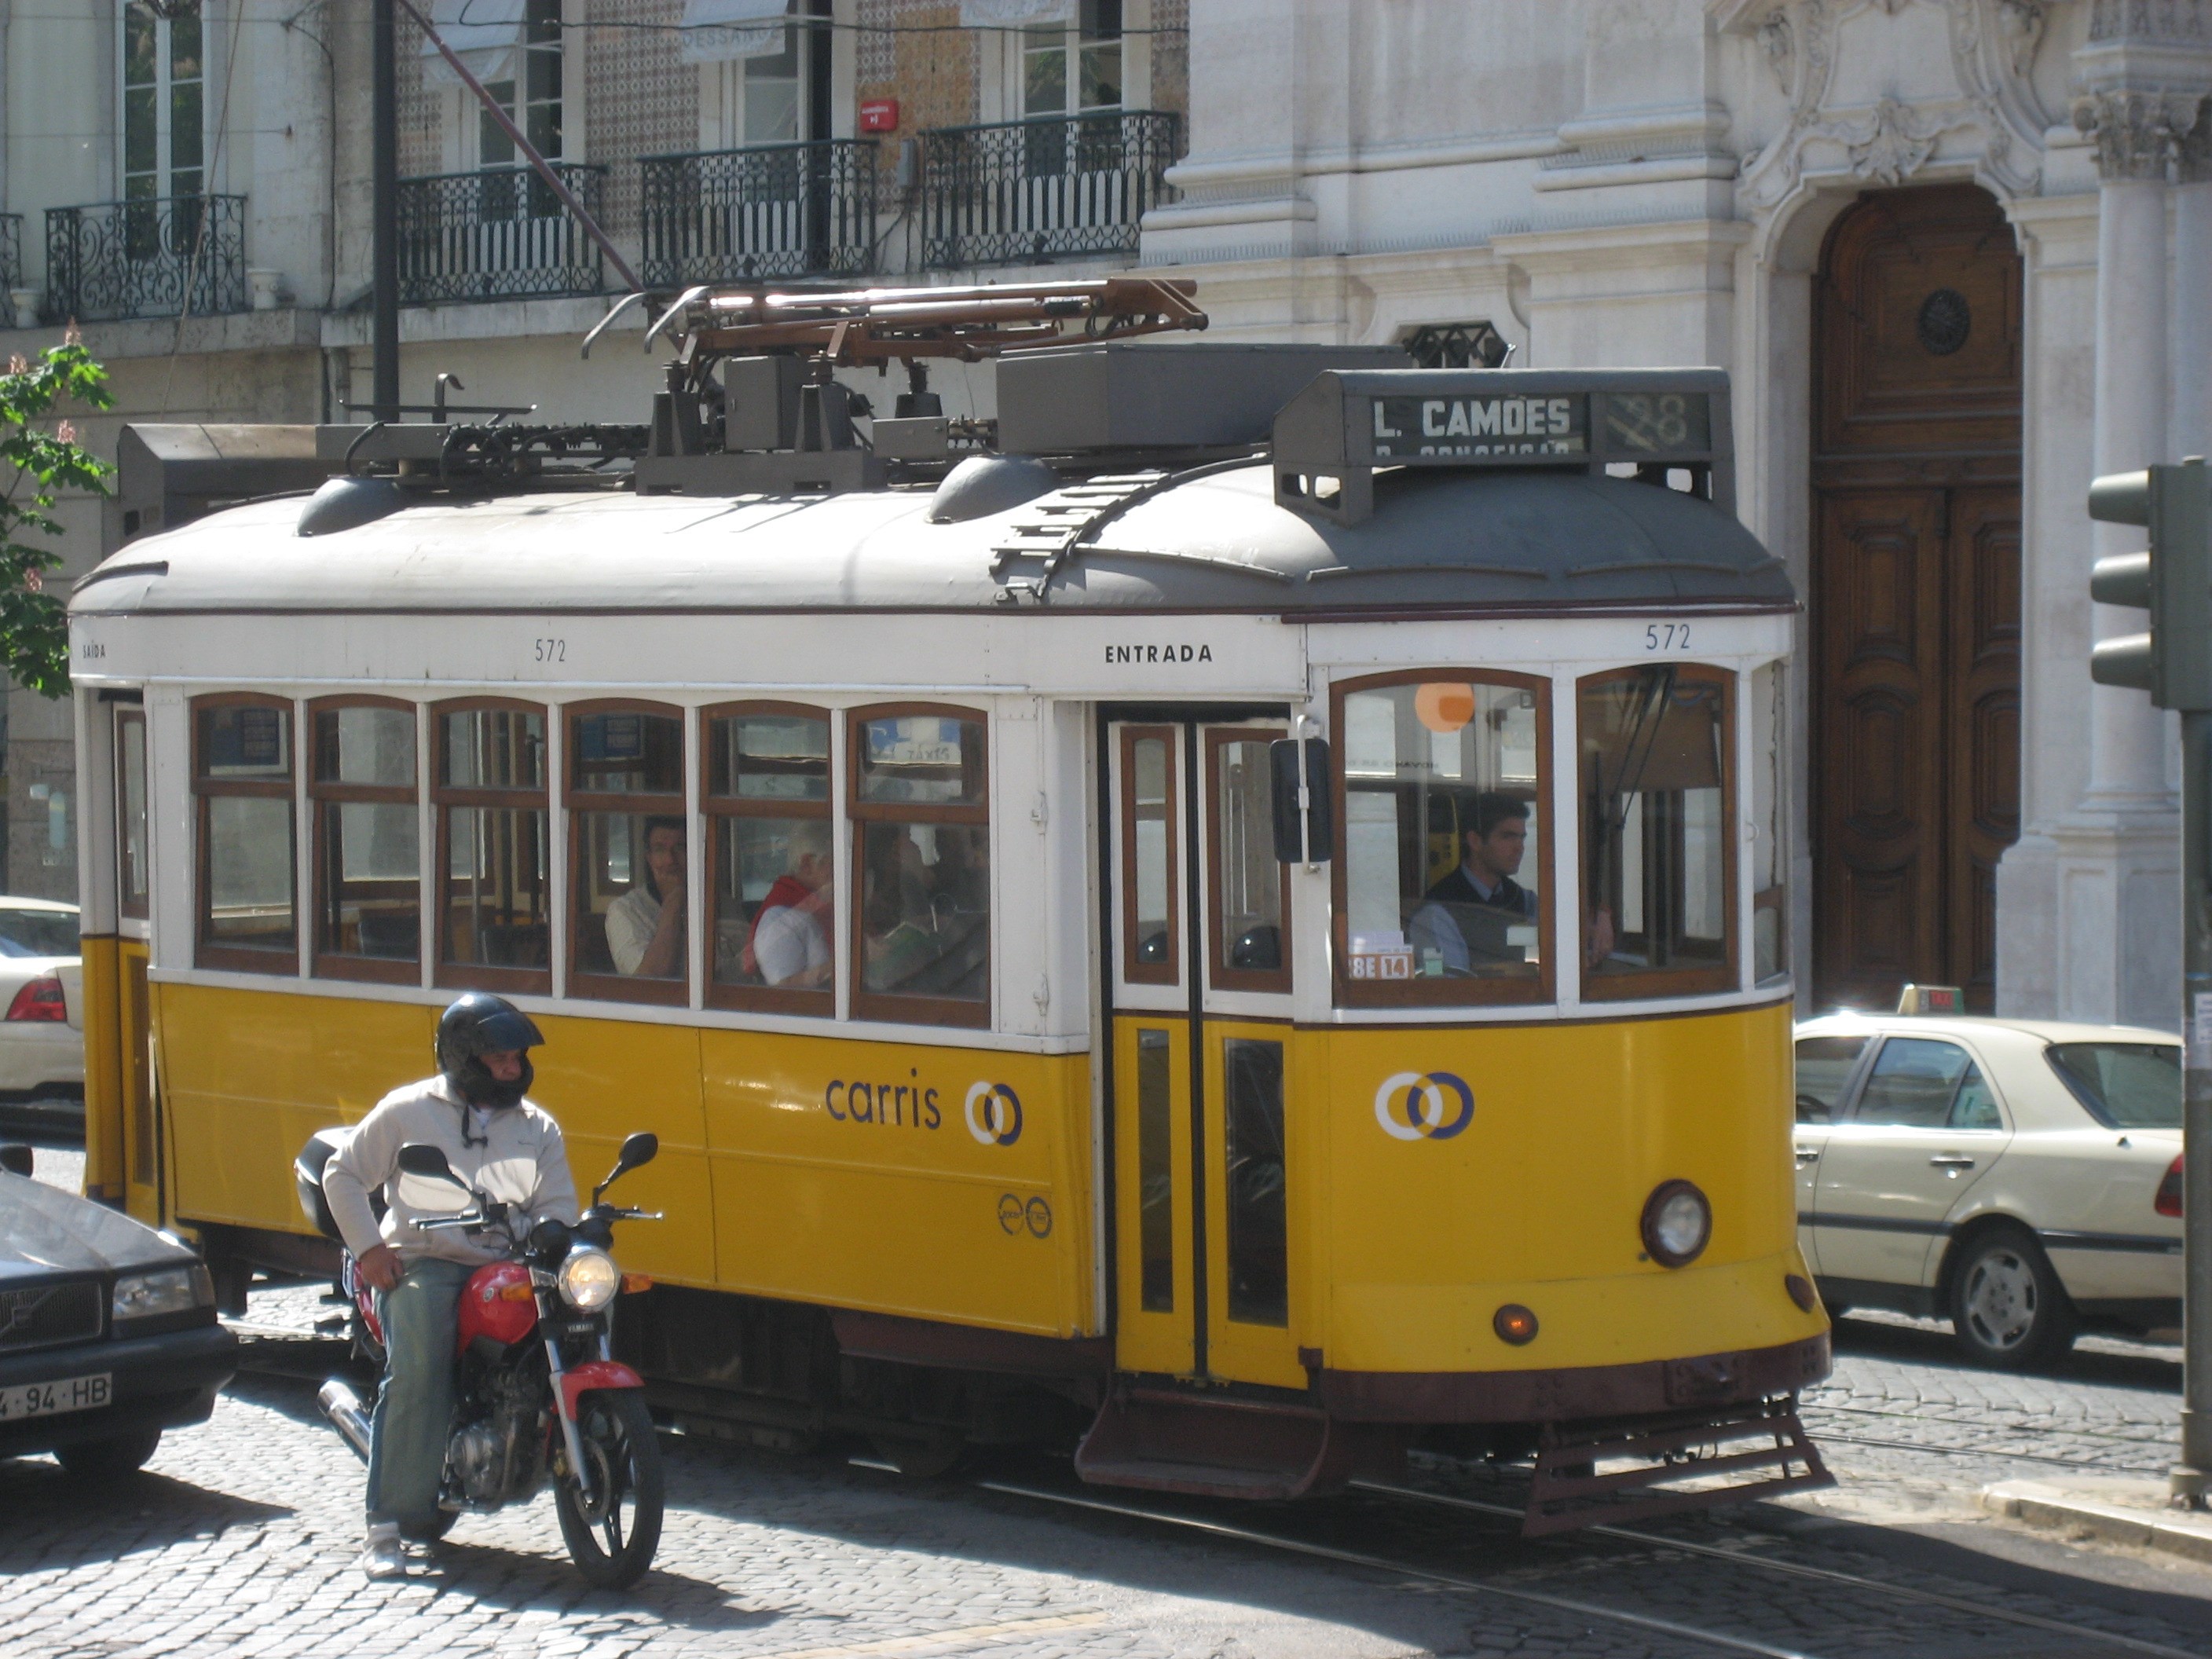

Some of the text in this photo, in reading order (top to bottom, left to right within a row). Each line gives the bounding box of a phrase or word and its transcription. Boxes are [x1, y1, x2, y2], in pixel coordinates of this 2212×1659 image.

[1374, 401, 1402, 437] L.
[1645, 624, 1690, 650] 572
[535, 639, 566, 661] 572
[1105, 644, 1213, 663] ENTRADA
[1349, 957, 1404, 979] 8E 14
[826, 1067, 942, 1130] carris
